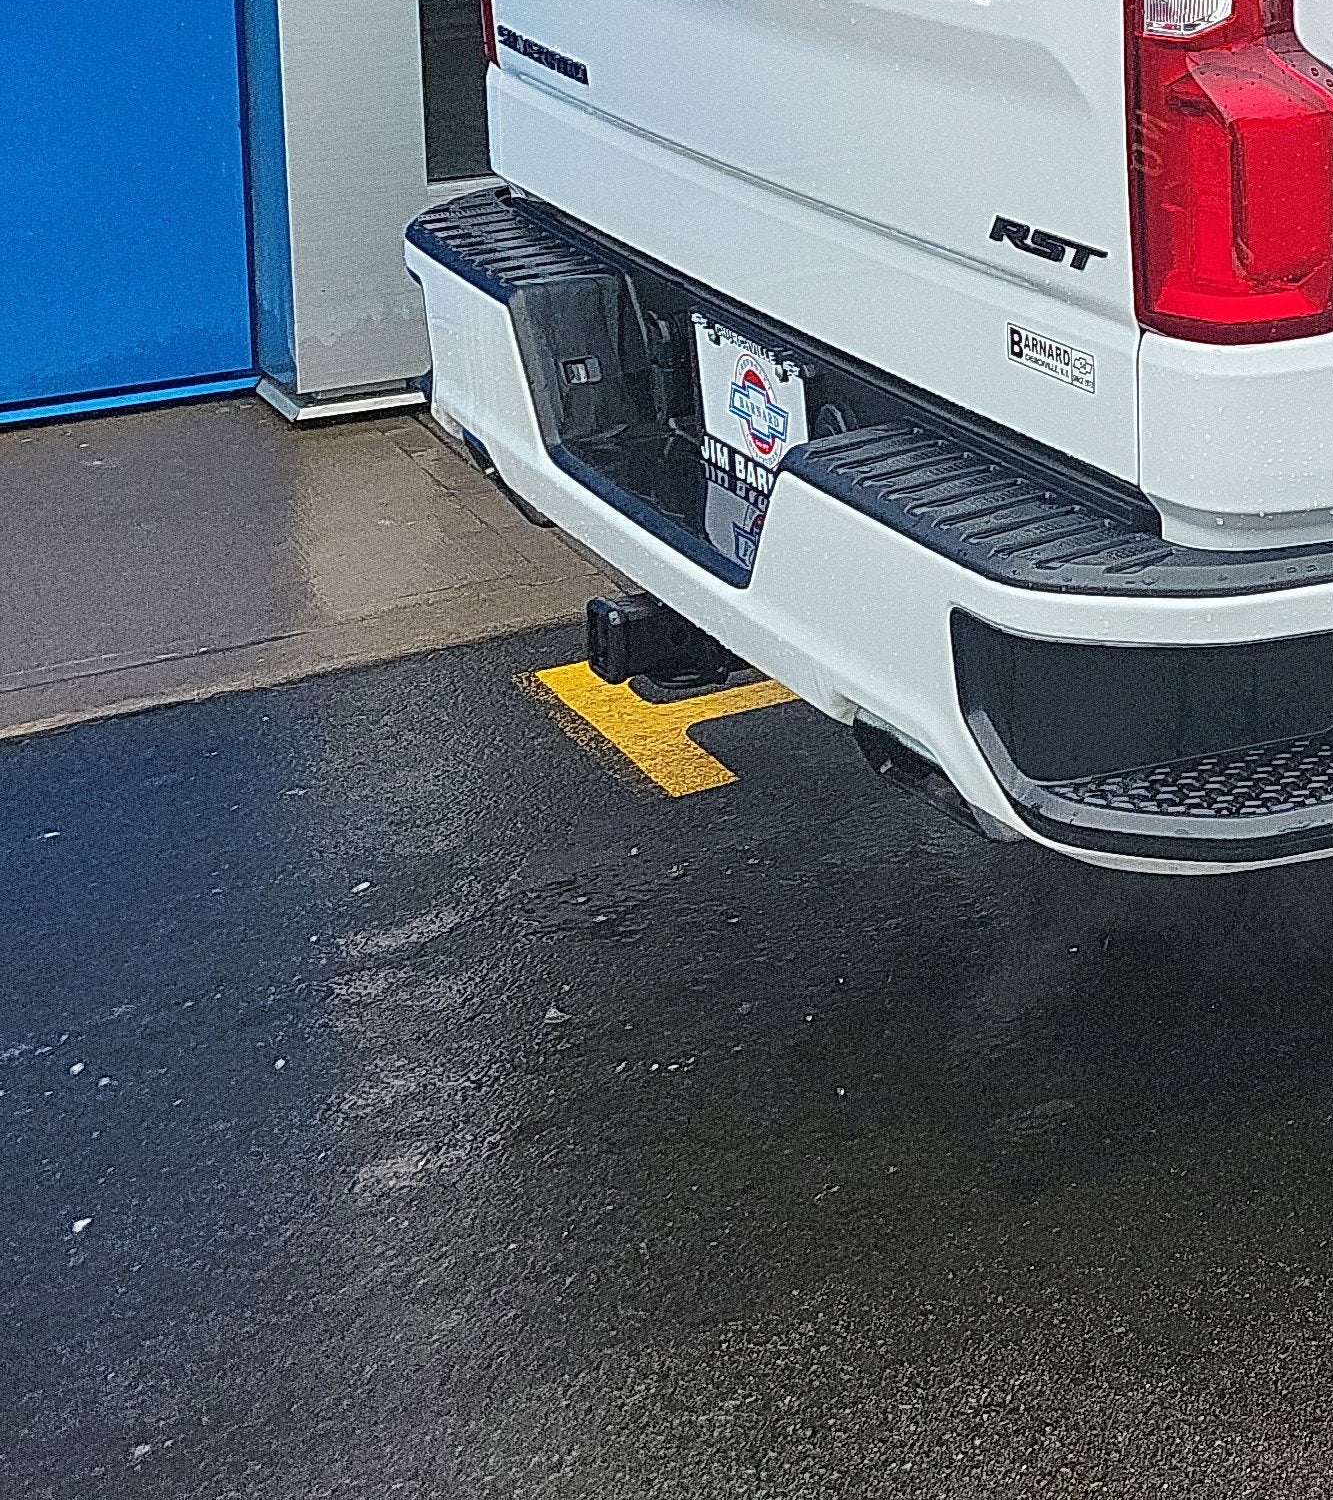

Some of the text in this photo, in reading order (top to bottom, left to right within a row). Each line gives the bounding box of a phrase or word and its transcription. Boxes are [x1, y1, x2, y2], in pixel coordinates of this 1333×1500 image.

[989, 215, 1108, 271] RST
[1009, 327, 1070, 367] BARNARD
[701, 435, 729, 471] JIM
